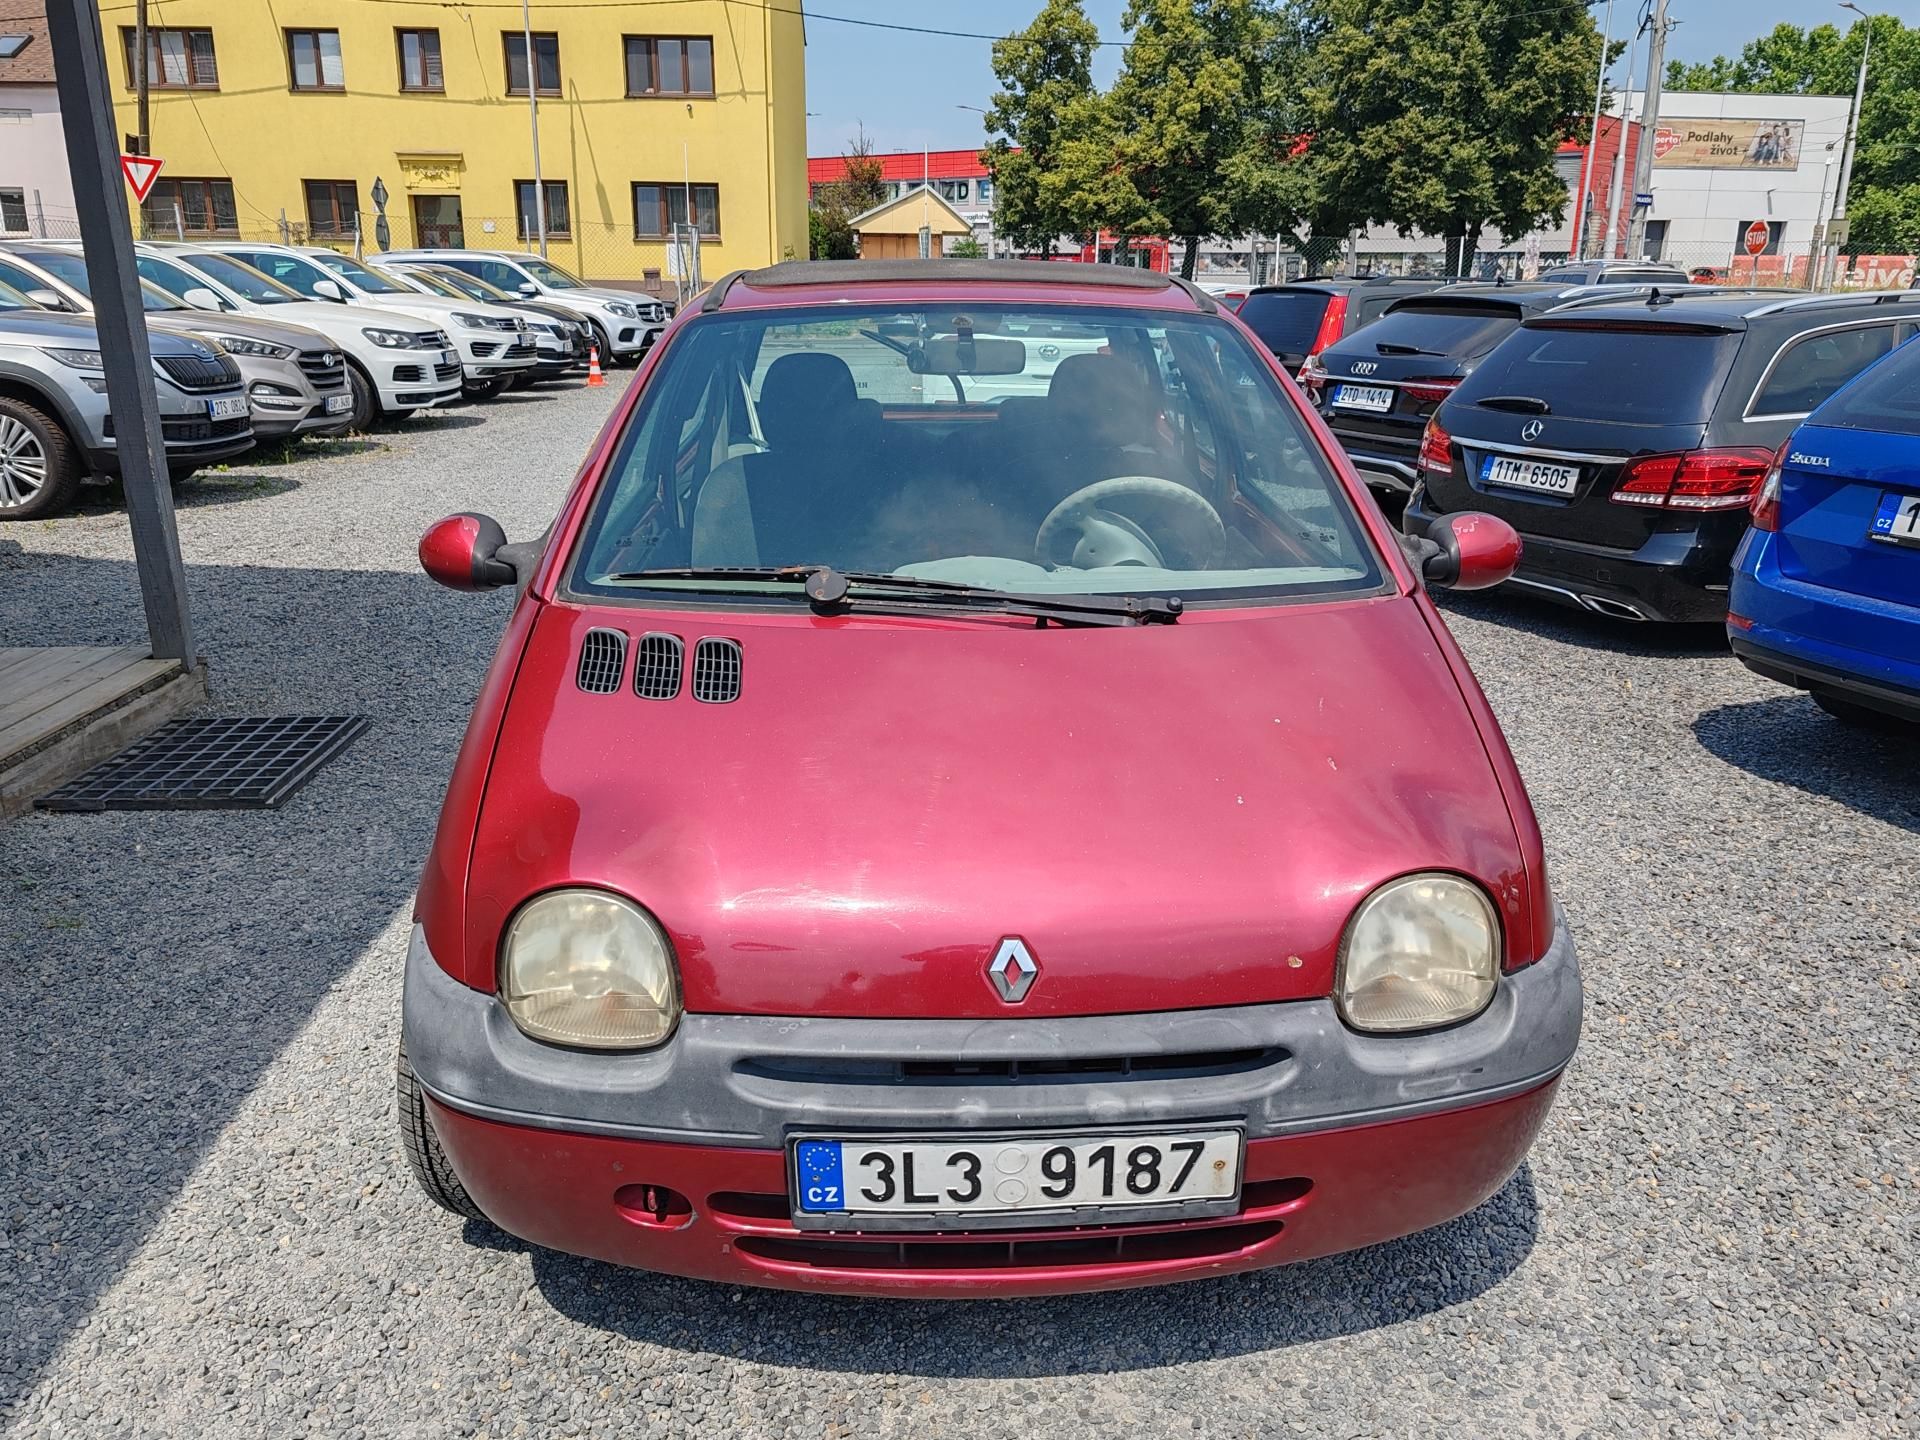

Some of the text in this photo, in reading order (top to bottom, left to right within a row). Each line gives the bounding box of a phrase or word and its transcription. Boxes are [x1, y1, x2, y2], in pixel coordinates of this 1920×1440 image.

[1687, 131, 1734, 144] Podlahy
[1710, 144, 1738, 156] život
[1747, 231, 1766, 246] STOP
[1366, 389, 1388, 406] 1414
[215, 399, 228, 416] 2TS
[1789, 451, 1831, 467] ŠKODA
[1496, 460, 1523, 482] 1TM
[1529, 465, 1571, 489] 6505
[1876, 518, 1892, 529] CZ
[859, 1139, 1205, 1204] 3L3 9187
[808, 1186, 839, 1202] CZ
